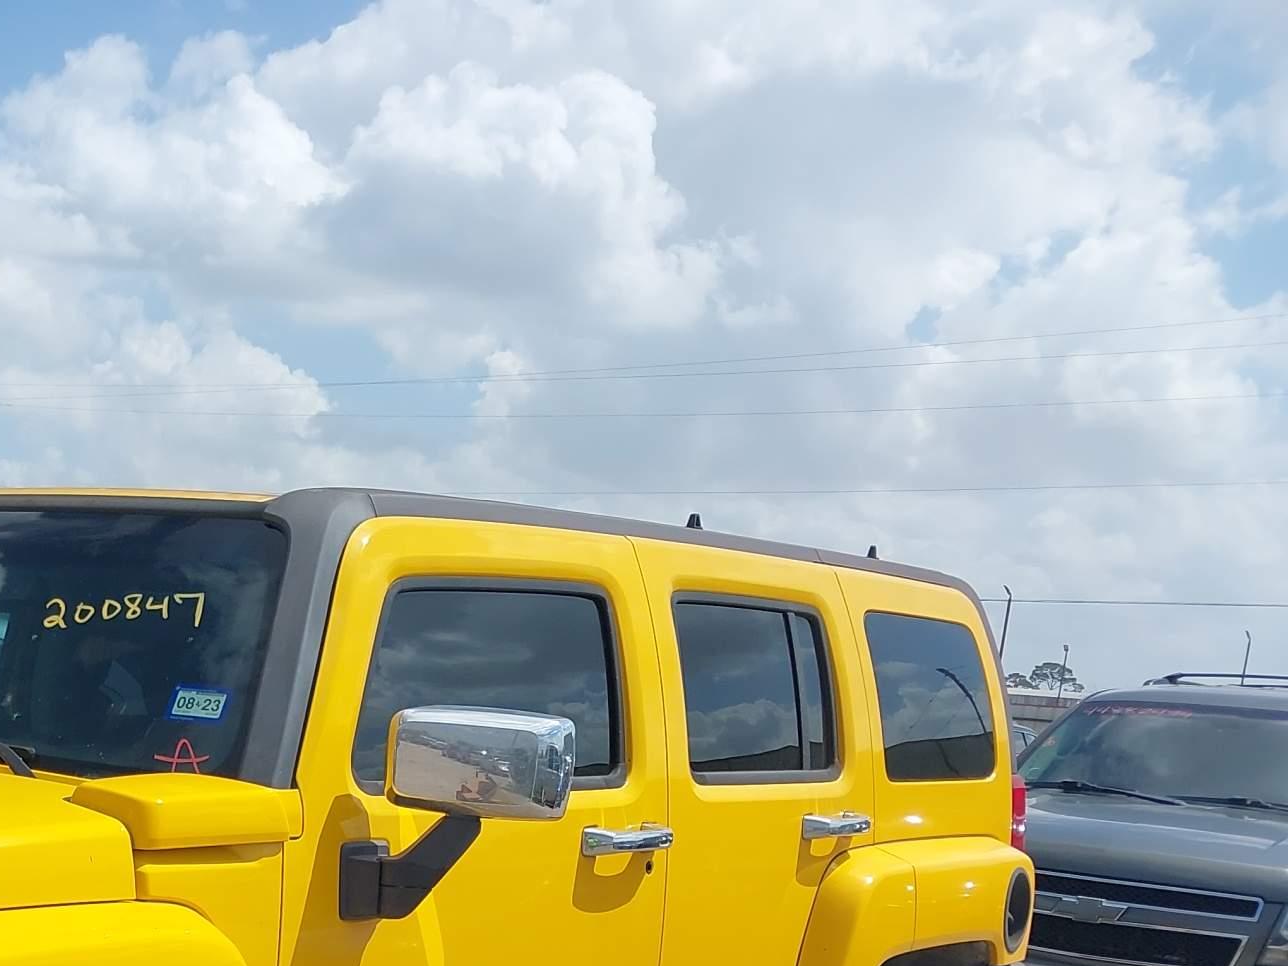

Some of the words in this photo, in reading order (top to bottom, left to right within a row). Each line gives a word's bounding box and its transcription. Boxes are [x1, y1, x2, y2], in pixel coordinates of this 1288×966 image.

[42, 591, 206, 630] 200847
[176, 696, 196, 710] 08
[201, 698, 221, 712] 23
[153, 736, 211, 773] A
